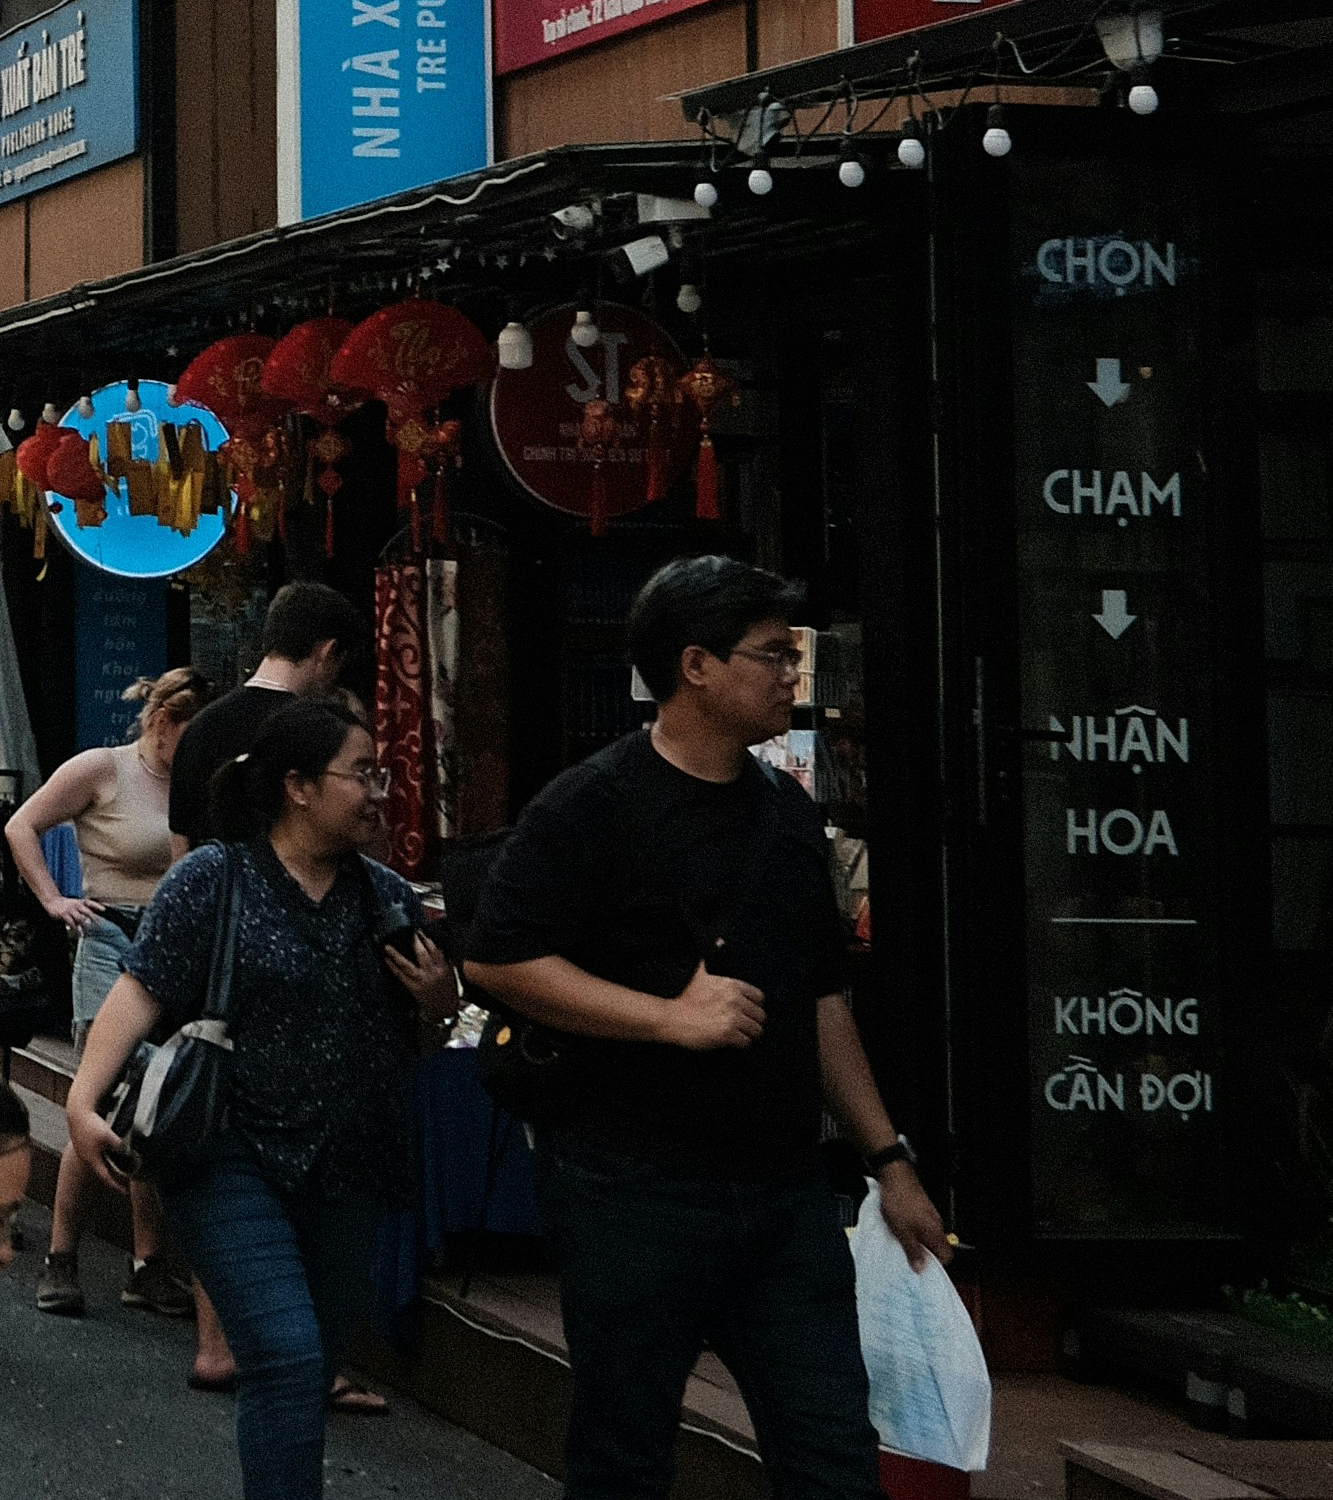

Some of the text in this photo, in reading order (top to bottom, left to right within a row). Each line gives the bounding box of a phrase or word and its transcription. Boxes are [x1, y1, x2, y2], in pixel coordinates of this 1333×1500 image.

[416, 38, 447, 93] TRE
[341, 49, 401, 159] NHÀ
[1037, 237, 1176, 297] CHỌN
[1043, 468, 1182, 529] CHẠM
[1049, 704, 1189, 776] NHẬN
[1066, 808, 1179, 857] HOA
[1054, 987, 1199, 1037] KHÔNG
[1044, 1054, 1213, 1122] CẦN ĐỢI
